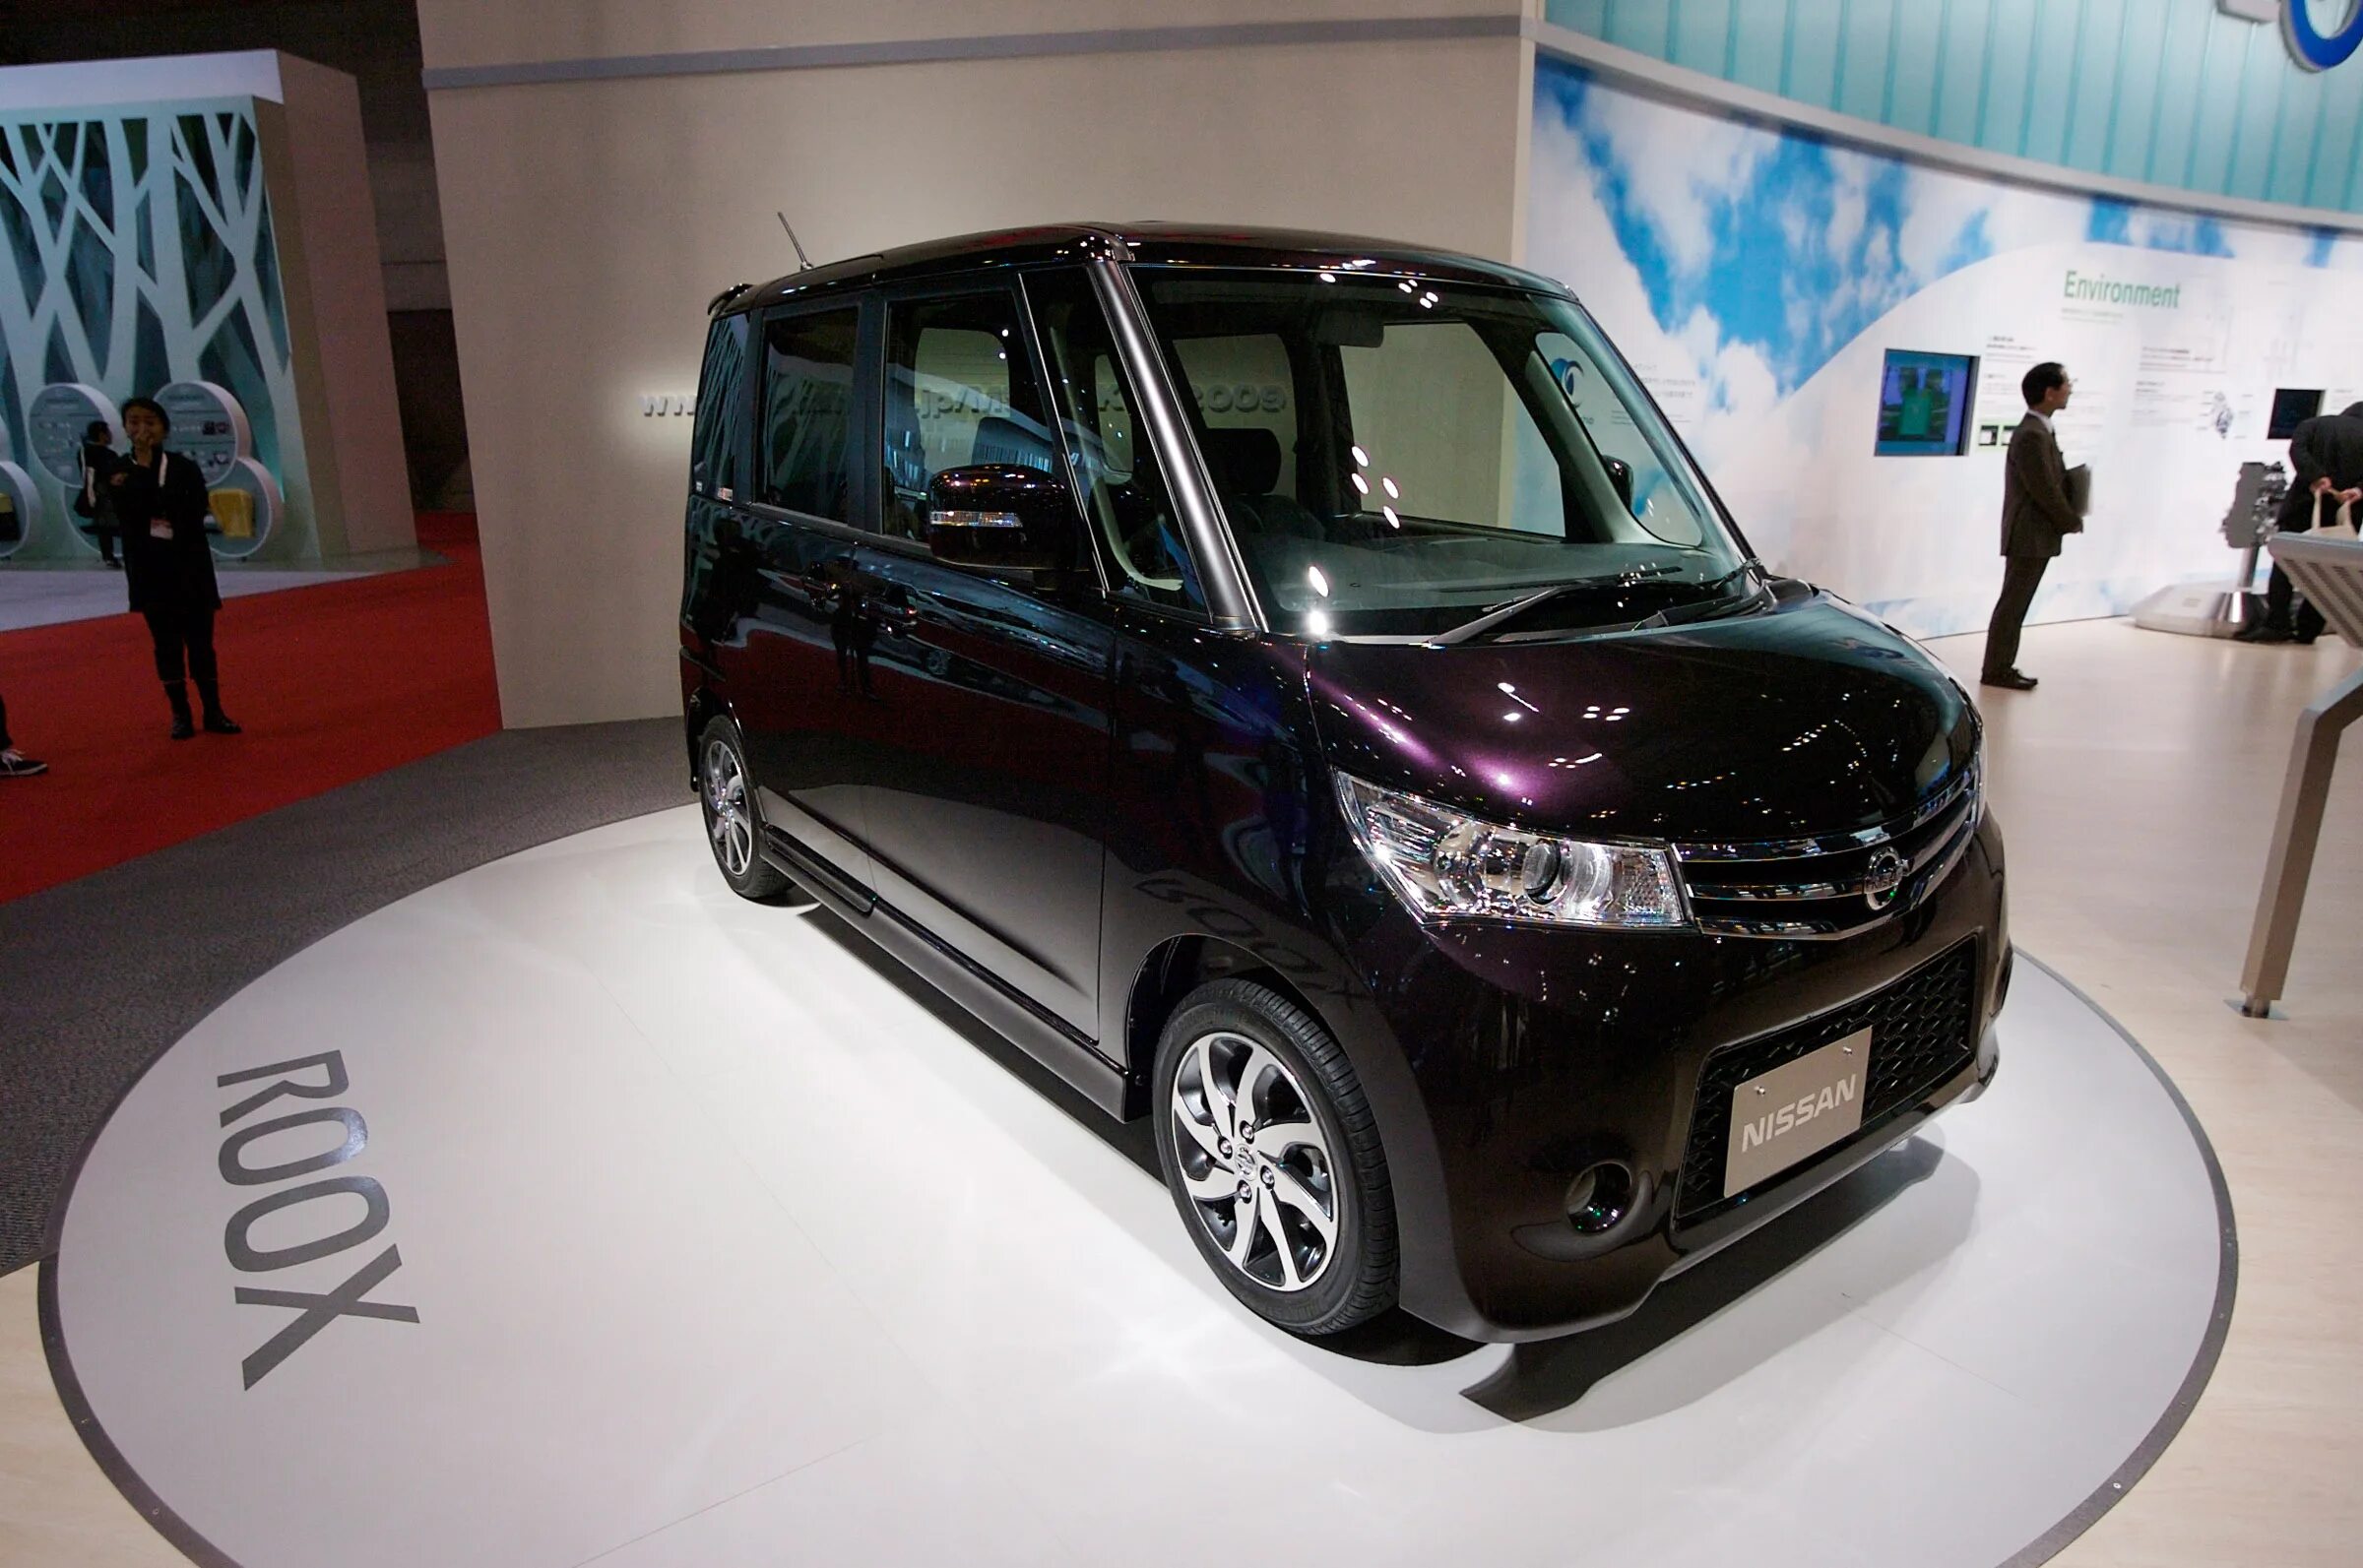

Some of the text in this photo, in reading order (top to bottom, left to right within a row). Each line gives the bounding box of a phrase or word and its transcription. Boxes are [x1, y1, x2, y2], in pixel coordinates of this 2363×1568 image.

[2064, 270, 2182, 309] Environment
[1741, 1073, 1857, 1154] NISSAN
[216, 1048, 421, 1392] ROOX
